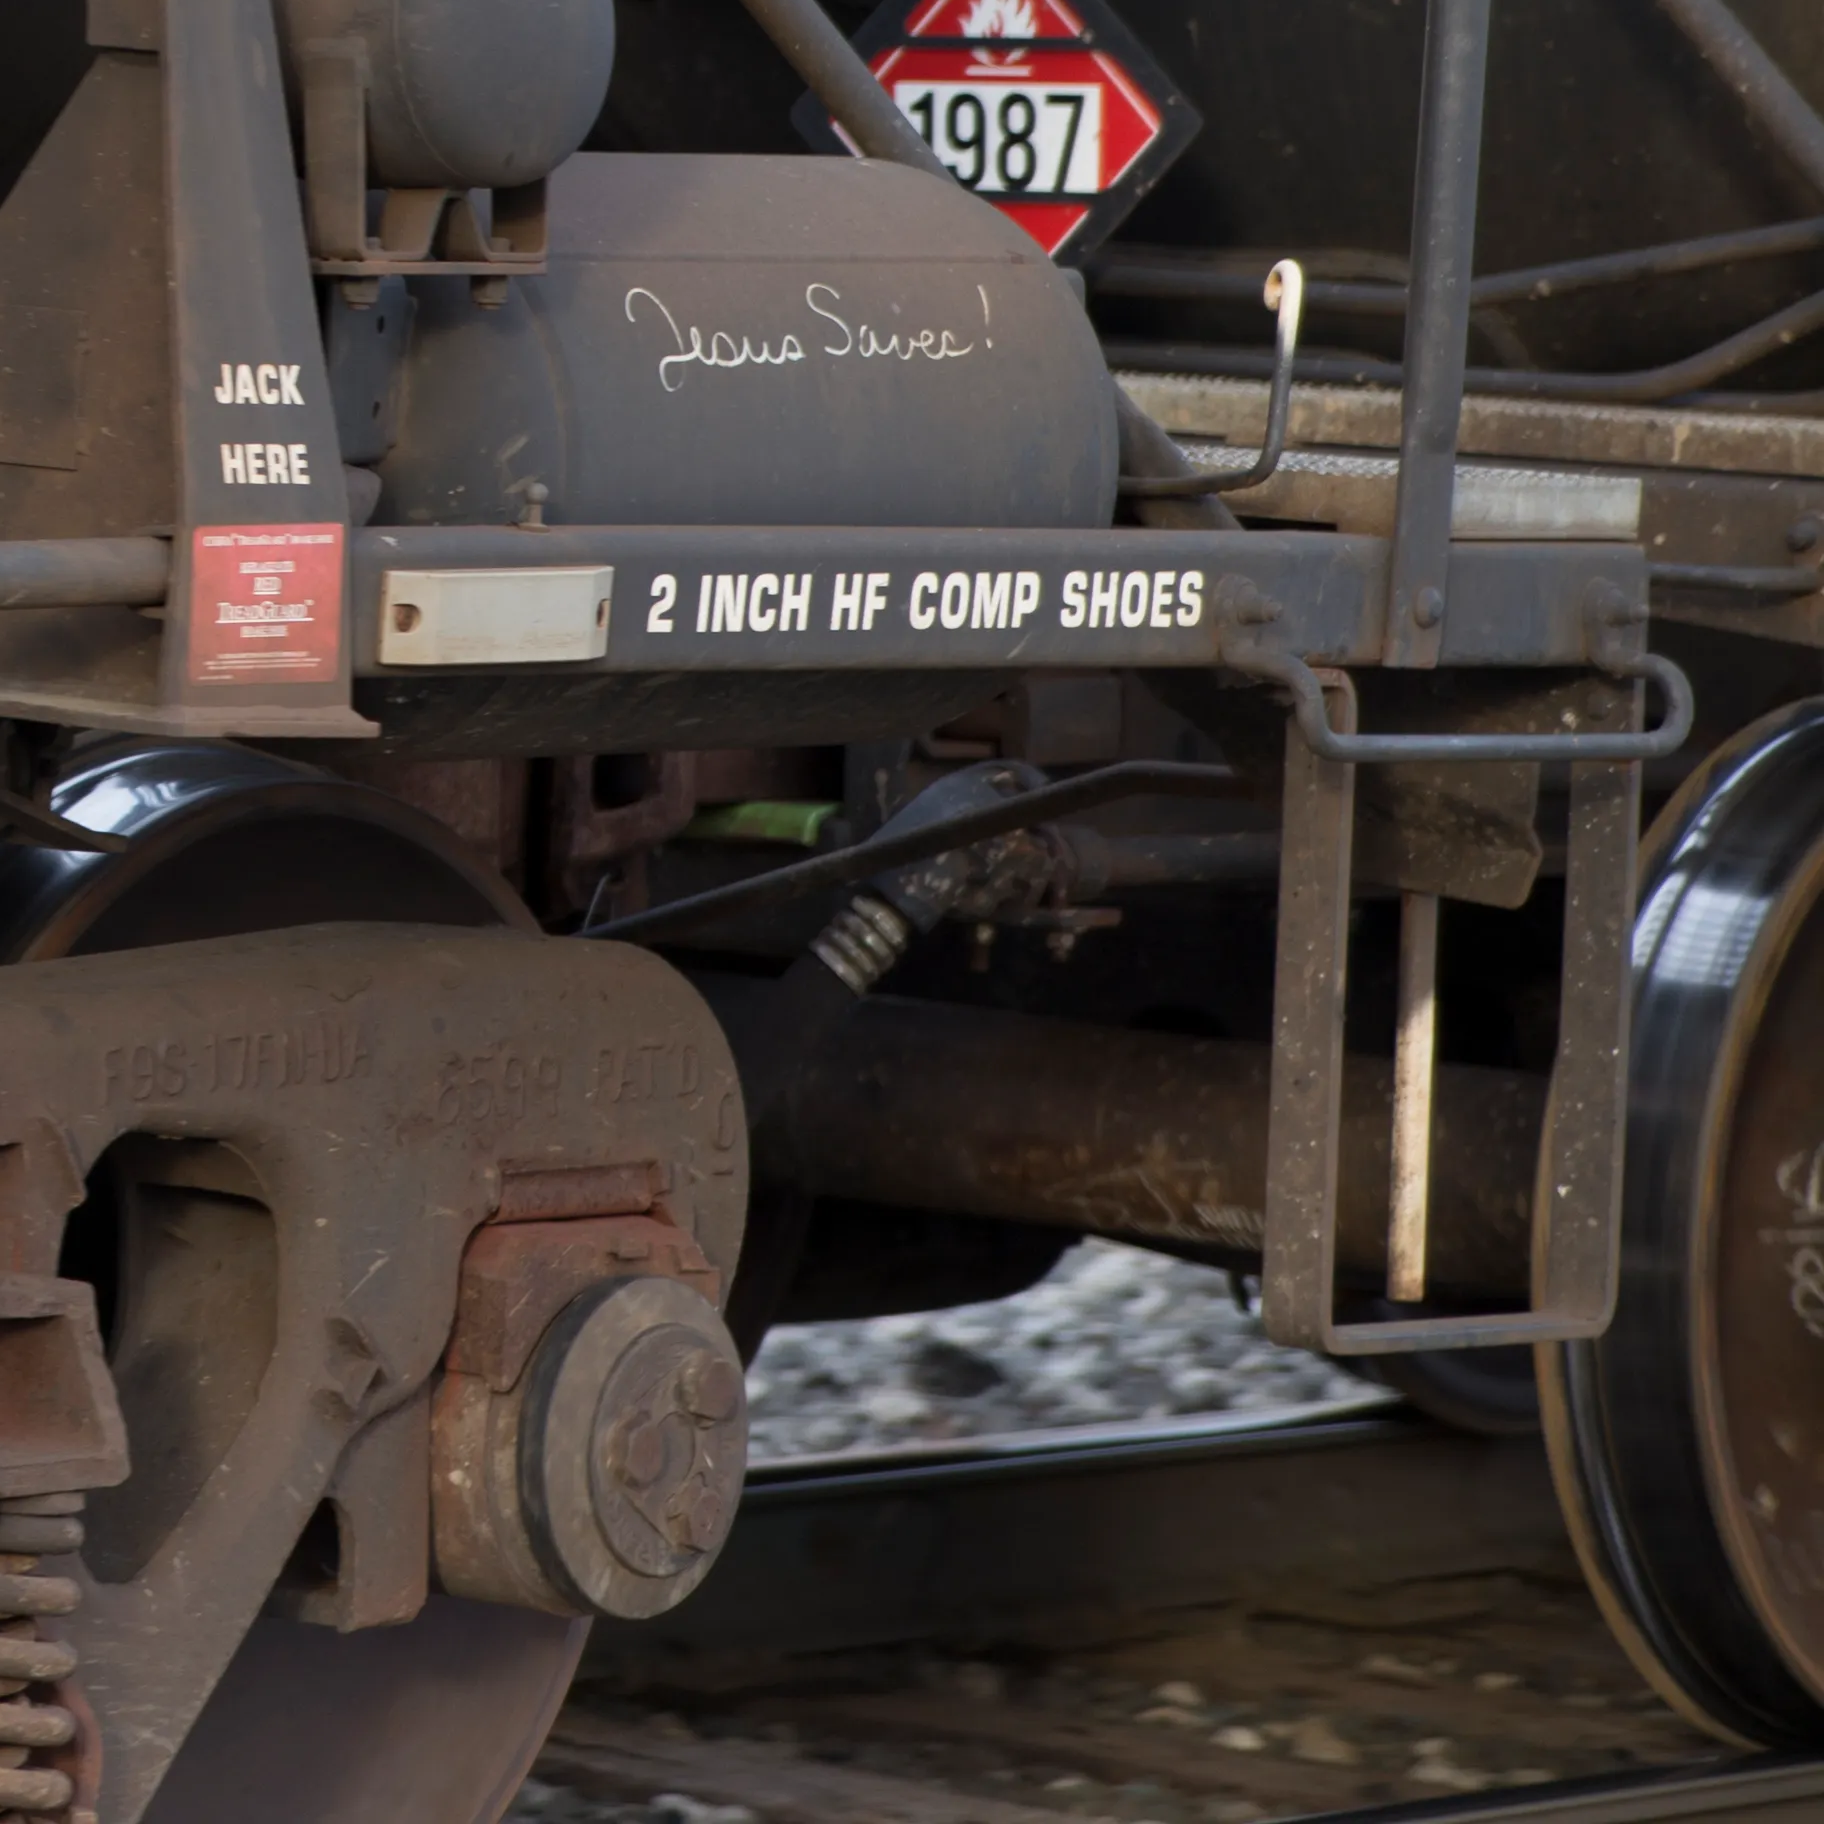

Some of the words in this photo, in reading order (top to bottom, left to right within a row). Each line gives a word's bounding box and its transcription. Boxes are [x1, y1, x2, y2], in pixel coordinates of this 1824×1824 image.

[625, 286, 806, 392] Jesus
[214, 363, 306, 405] JACK
[220, 443, 311, 485] HERE
[646, 573, 678, 633] 2
[696, 572, 812, 633] INCH
[829, 572, 888, 632] HF
[909, 570, 1040, 630] COMP
[1059, 570, 1205, 629] SHOES
